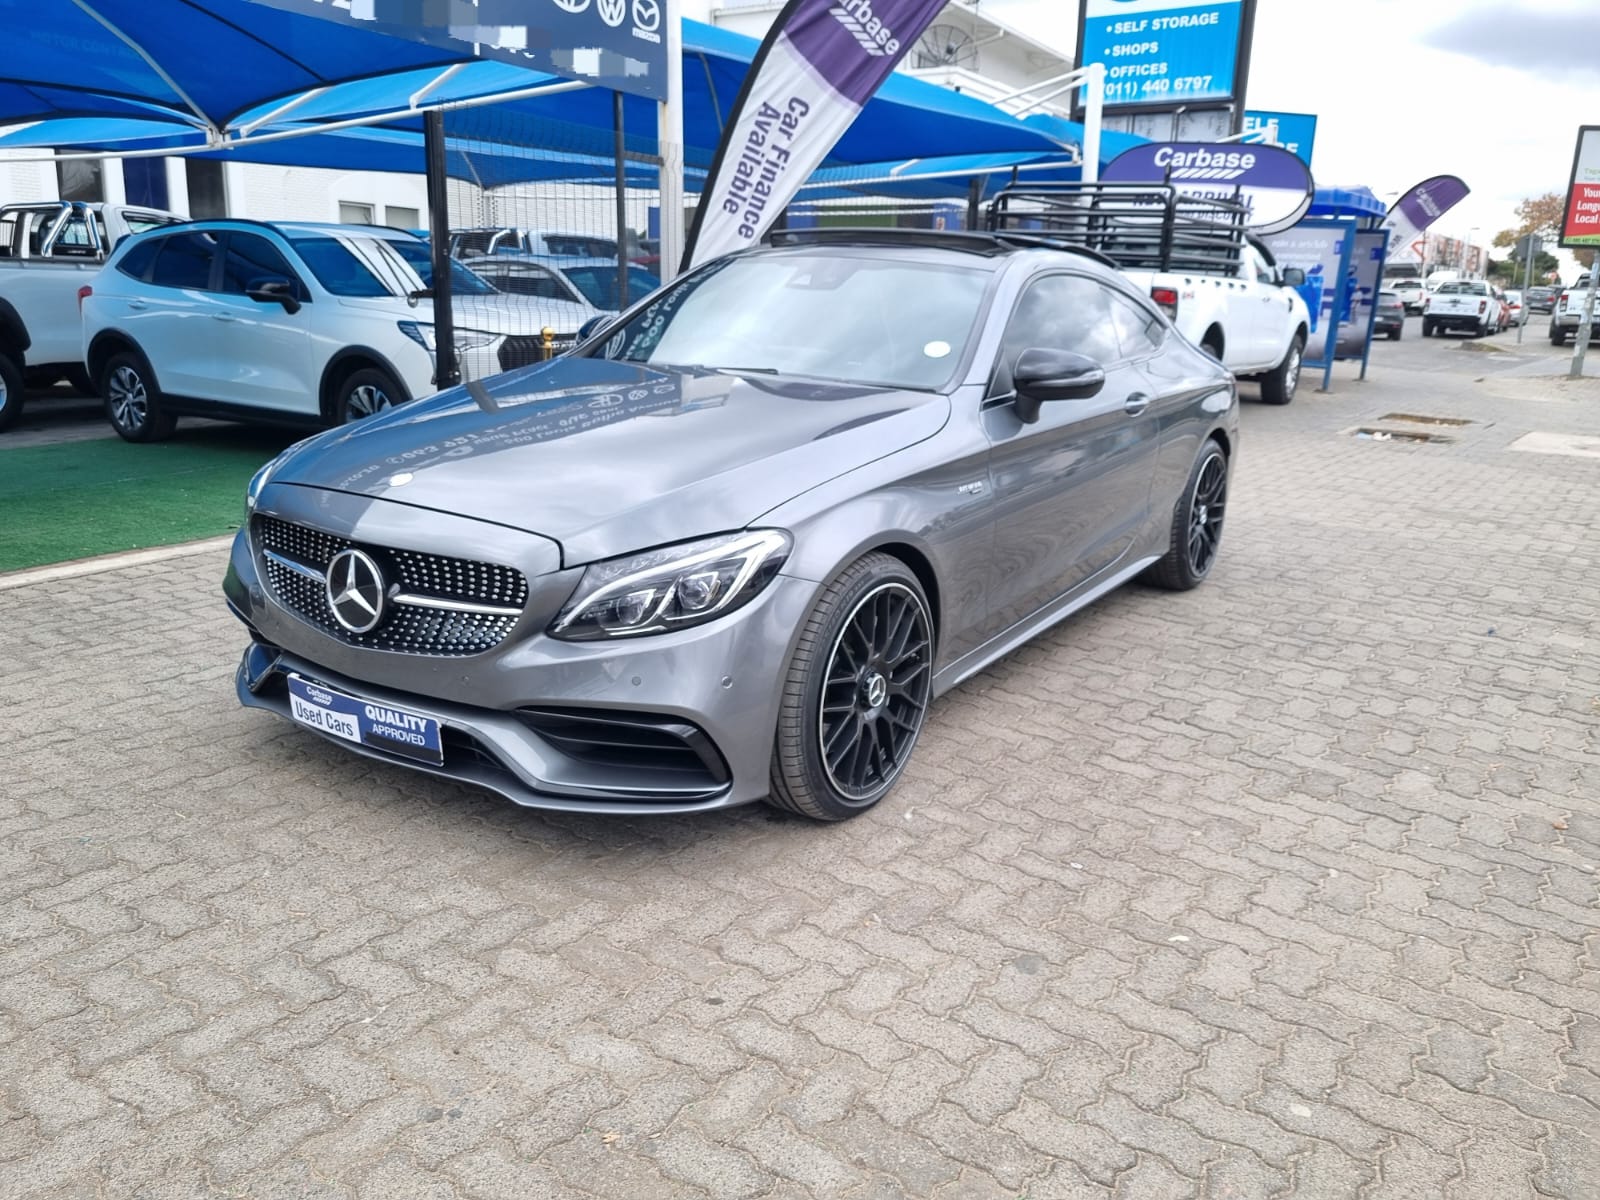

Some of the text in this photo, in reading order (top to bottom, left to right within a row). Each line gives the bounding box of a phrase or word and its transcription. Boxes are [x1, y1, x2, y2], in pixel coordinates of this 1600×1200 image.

[1114, 12, 1220, 34] SELF STORAGE
[1111, 42, 1159, 57] SHOPS
[1110, 62, 1168, 78] OFFICES
[1141, 78, 1170, 92] 440
[1174, 75, 1212, 90] 6797
[723, 101, 782, 215] Available
[738, 96, 810, 240] Car Finance
[1153, 147, 1256, 169] Carbase
[1583, 187, 1600, 198] You
[1575, 213, 1598, 224] Local
[306, 686, 333, 703] Carbase
[296, 701, 354, 737] Used Cars
[364, 705, 428, 733] QUALITY
[372, 724, 426, 746] APPROVED
